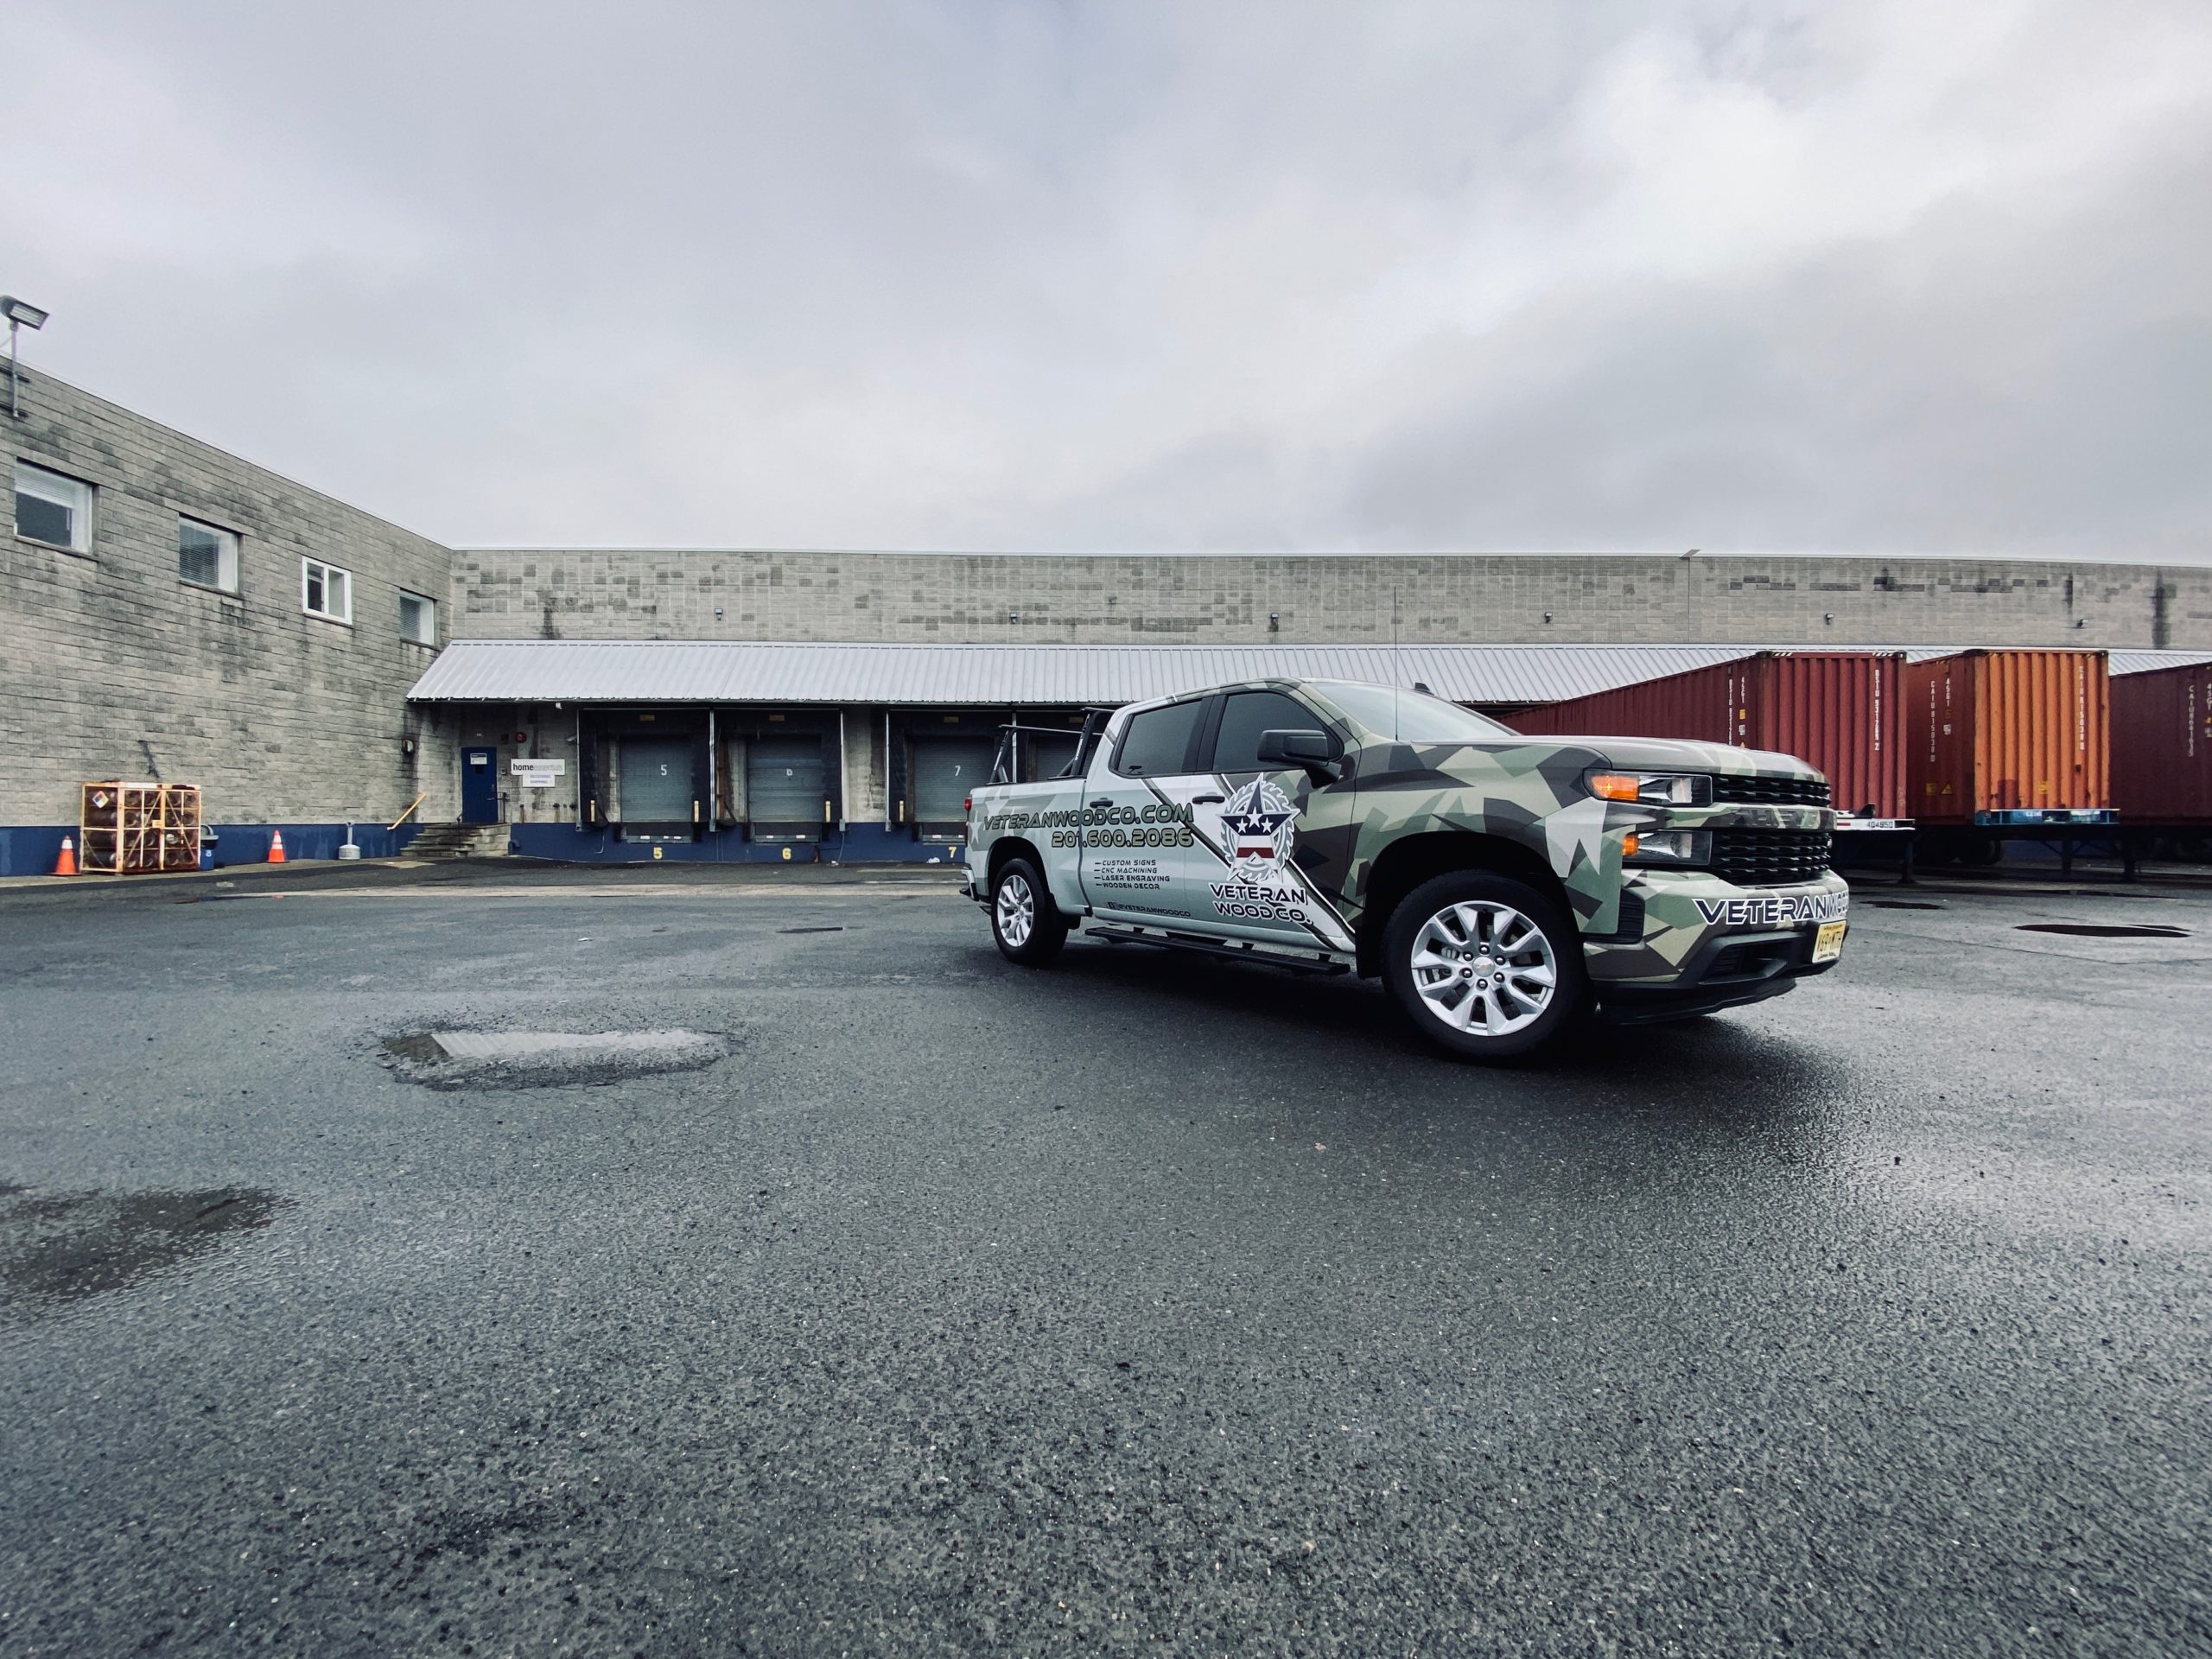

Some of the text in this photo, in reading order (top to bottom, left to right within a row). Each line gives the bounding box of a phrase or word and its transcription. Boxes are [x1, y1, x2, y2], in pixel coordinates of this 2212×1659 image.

[660, 764, 668, 776] 5
[954, 765, 961, 777] 7
[982, 802, 1195, 831] VETERANWOODCO.COM
[1051, 827, 1194, 849] 201.600.2086
[653, 847, 663, 860] 5
[782, 848, 791, 860] 6
[948, 846, 957, 858] 7
[1209, 883, 1308, 906] VETERAN
